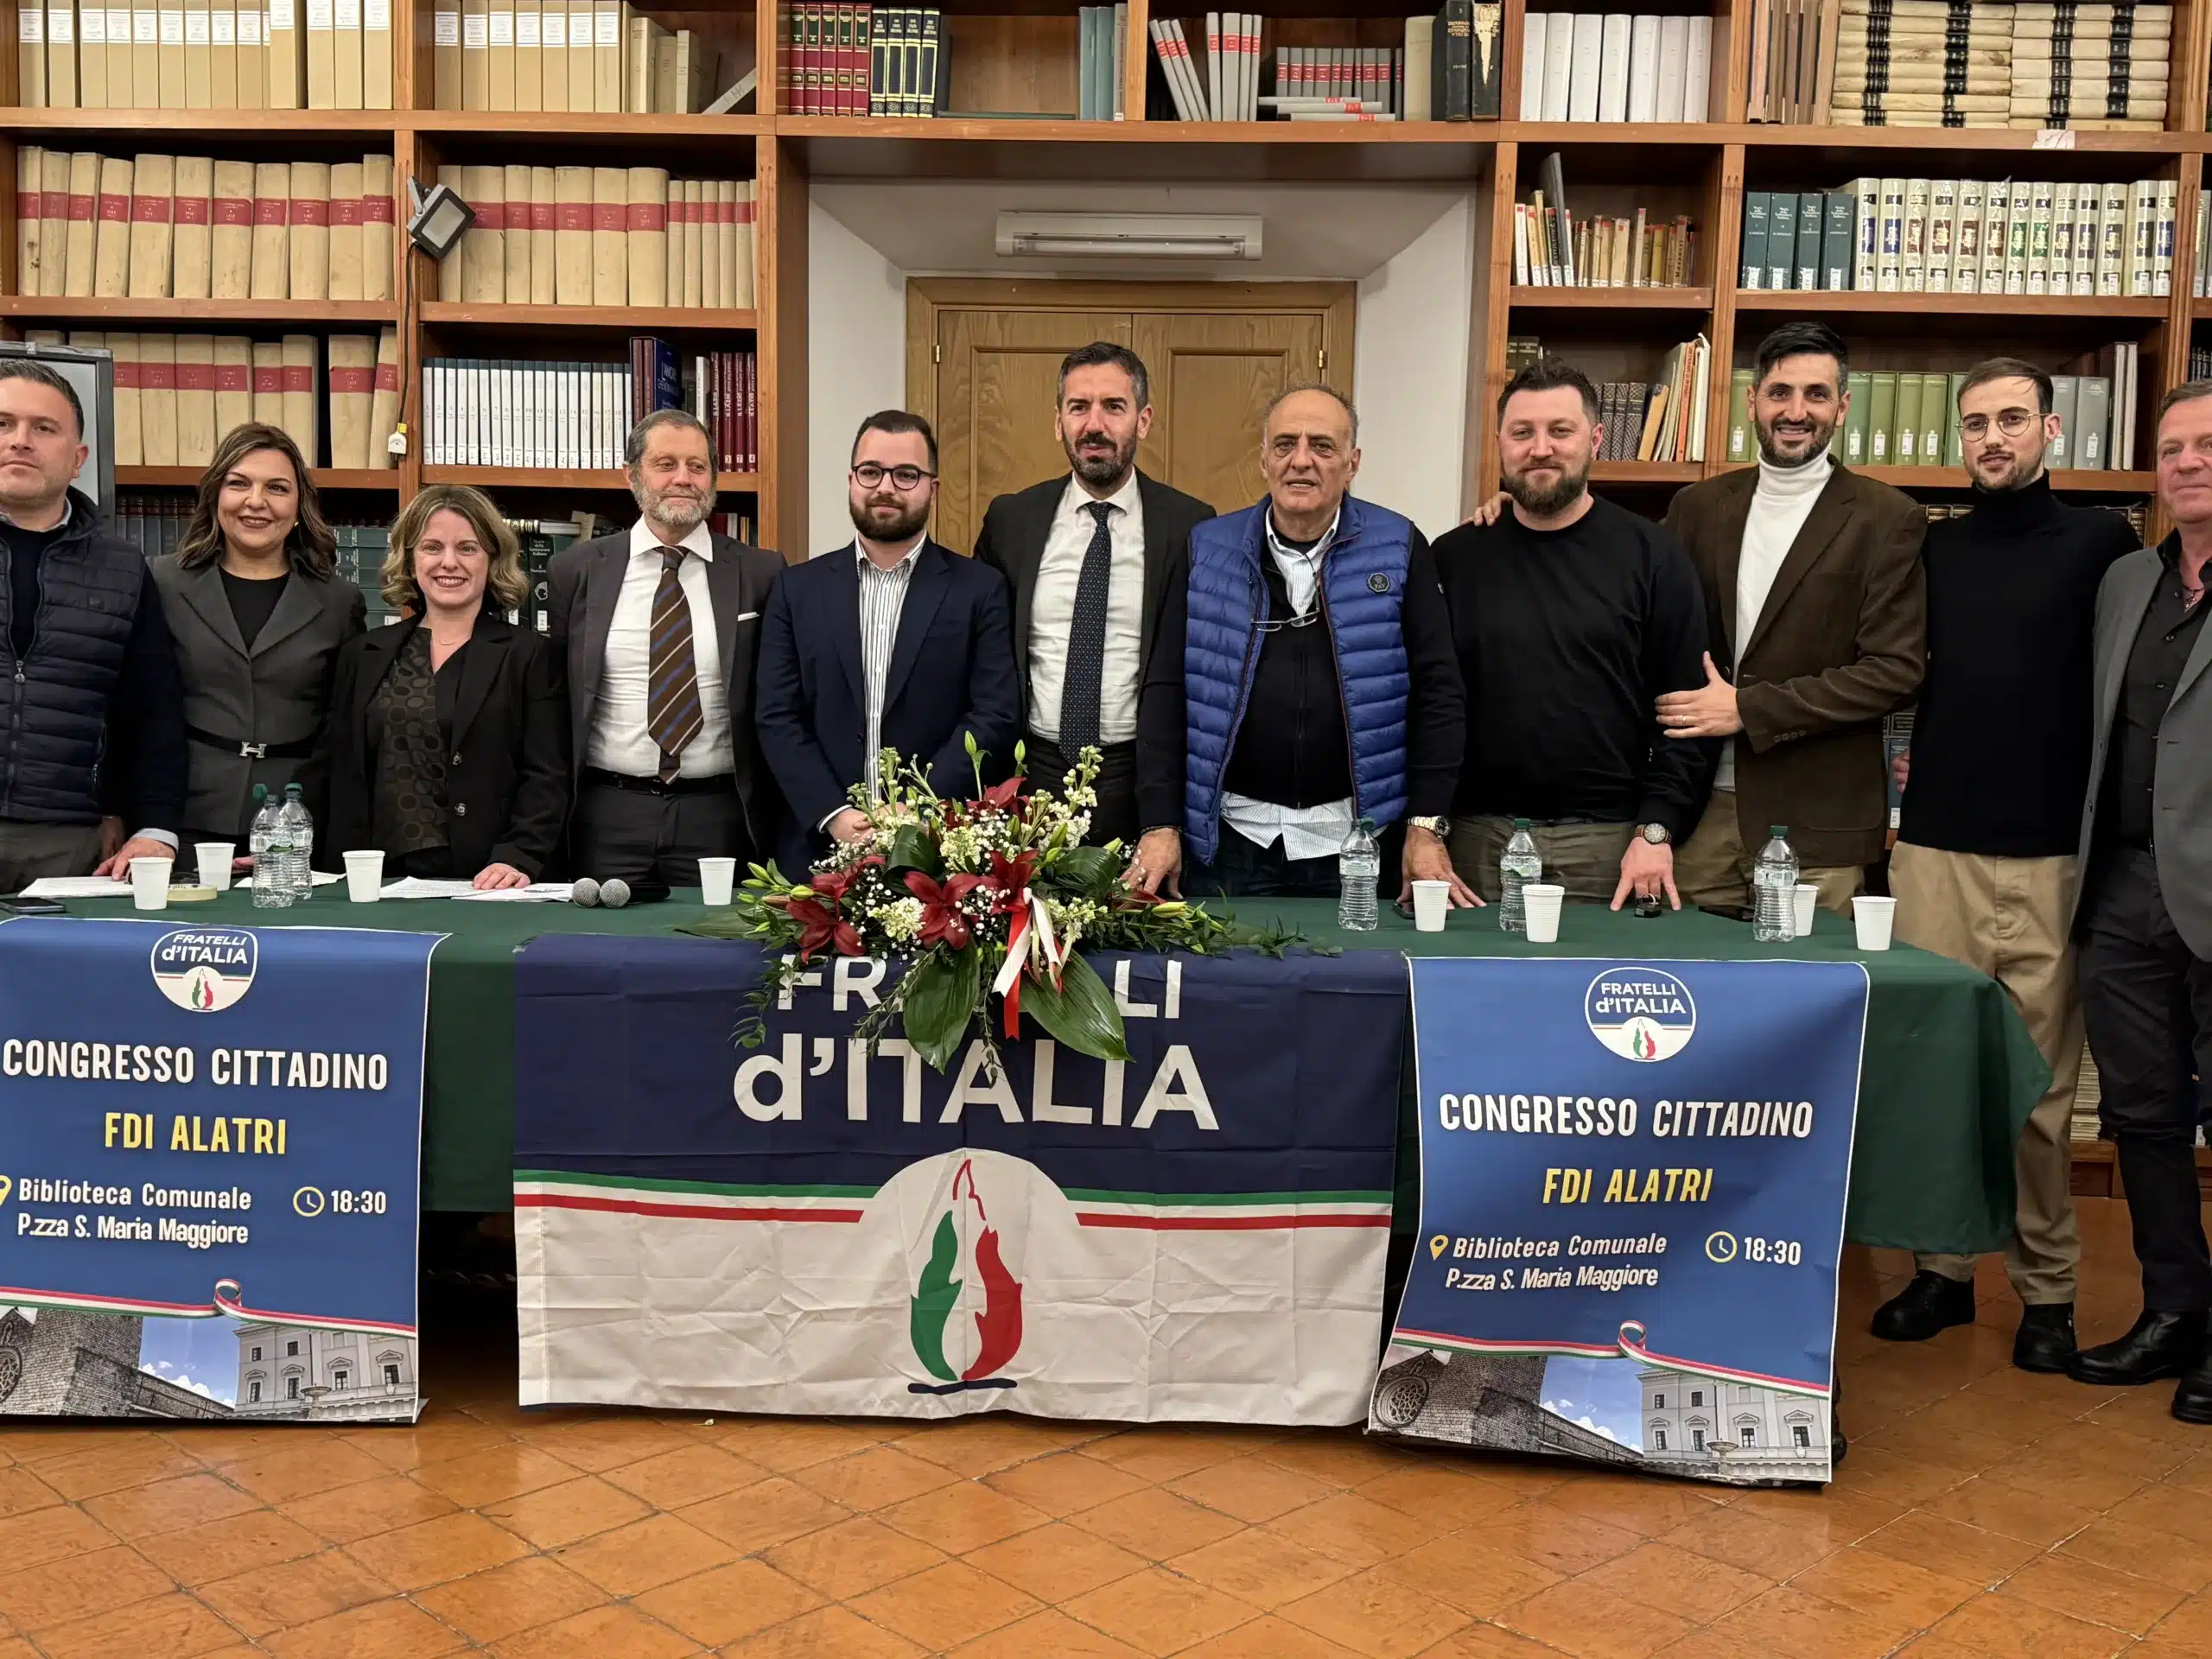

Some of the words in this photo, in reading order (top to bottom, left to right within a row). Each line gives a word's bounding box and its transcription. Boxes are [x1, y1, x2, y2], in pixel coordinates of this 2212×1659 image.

[162, 945, 248, 964] d'ITALIA
[173, 934, 248, 946] FRATELLI
[778, 953, 1181, 1020] FRLI
[1600, 982, 1676, 997] FRATELLI
[1595, 996, 1687, 1014] d'ITALIA
[3, 1039, 194, 1084] CONGRESSO
[212, 1048, 388, 1090] CITTADINO
[734, 1033, 1219, 1130] d'ITALIA
[1440, 1093, 1637, 1136] CONGRESSO
[1653, 1100, 1814, 1138] CITTADINO
[105, 1112, 154, 1150] FDI
[170, 1116, 287, 1154] ALATRI
[19, 1178, 132, 1205] Biblioteca
[142, 1183, 251, 1210] Comunale
[1542, 1168, 1592, 1204] FDI
[1604, 1168, 1713, 1203] ALATRI
[331, 1190, 387, 1215] 18:30
[17, 1213, 69, 1237] P.zza
[74, 1215, 92, 1238] S.
[98, 1216, 152, 1240] Maria
[159, 1217, 249, 1249] Maggiore
[1452, 1237, 1560, 1259] Biblioteca
[1567, 1233, 1668, 1256] Comunale
[1744, 1236, 1802, 1266] 18:30
[1446, 1268, 1496, 1291] P.zza
[1500, 1268, 1516, 1290] S.
[1521, 1267, 1572, 1289] Maria
[1576, 1263, 1659, 1292] Maggiore
